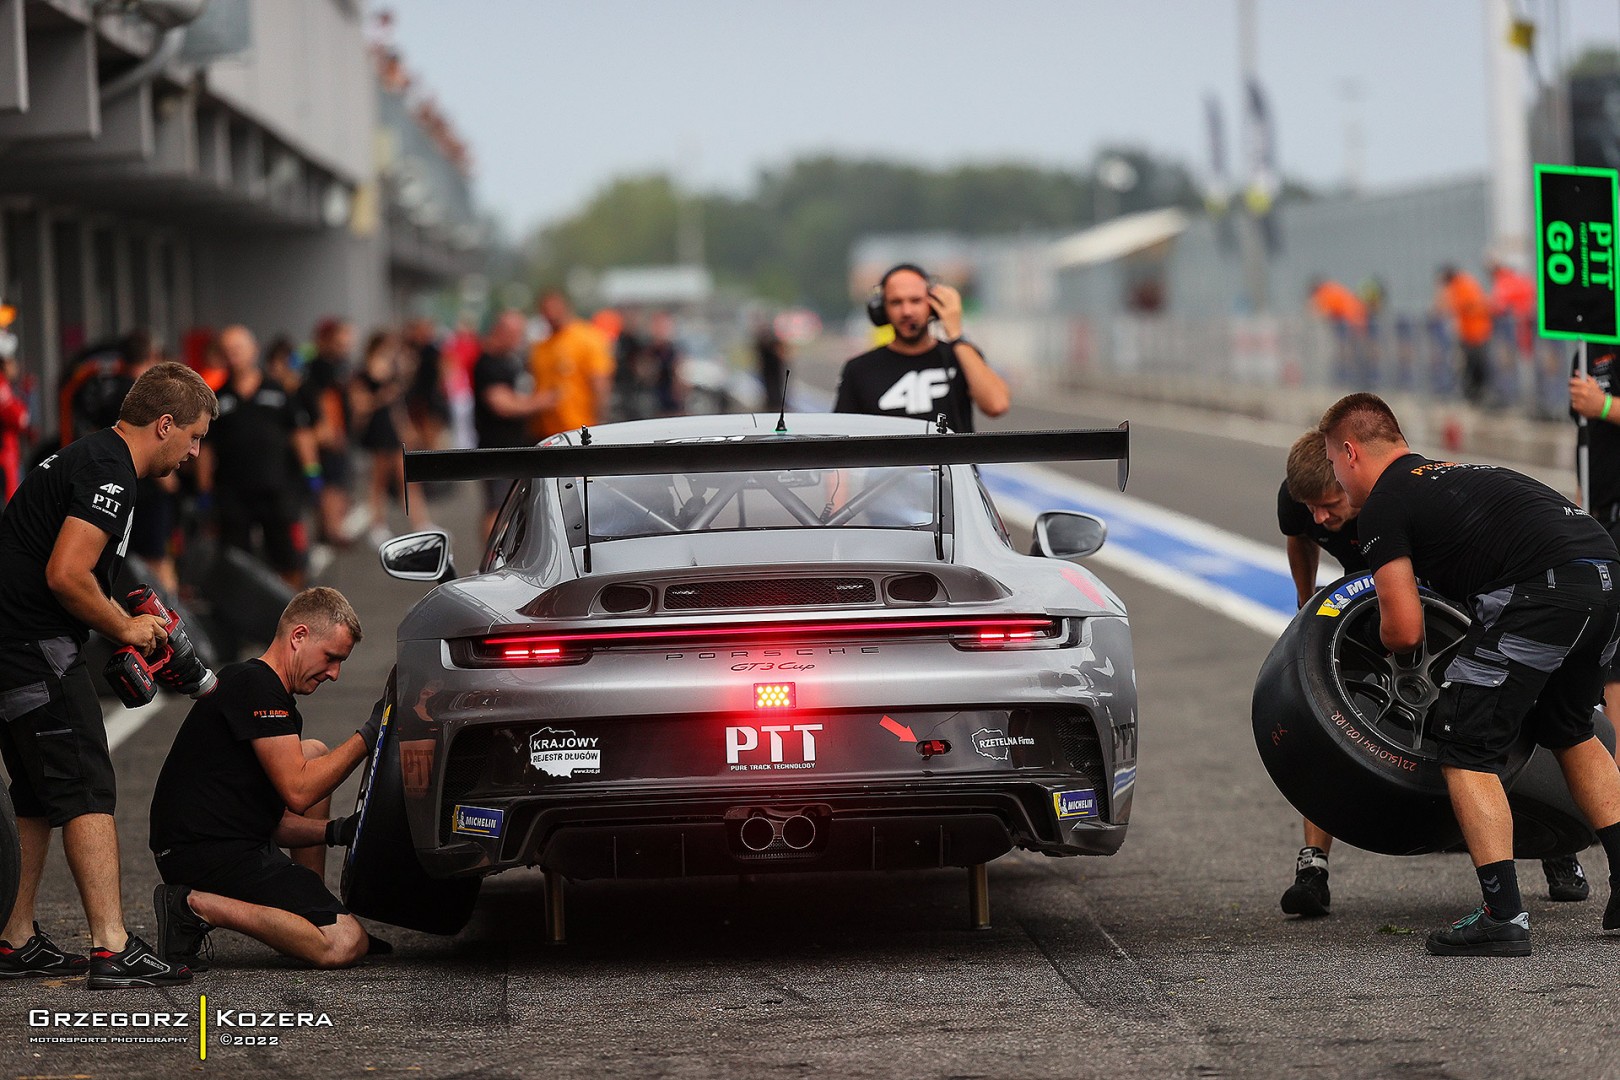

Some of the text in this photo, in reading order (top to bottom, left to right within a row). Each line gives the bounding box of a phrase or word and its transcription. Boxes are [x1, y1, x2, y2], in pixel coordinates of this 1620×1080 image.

[1546, 220, 1575, 285] GO
[1589, 221, 1613, 291] PTT
[878, 366, 957, 415] 4F
[100, 482, 124, 495] 4F
[92, 493, 122, 513] PTT
[666, 646, 880, 660] PORSCHE
[778, 661, 816, 672] Cup
[533, 737, 599, 750] KRAJOWY
[725, 723, 823, 764] PTT
[979, 736, 1018, 748] RZETELNA
[533, 751, 599, 763] REJESTR DŁUGÓW
[773, 762, 816, 770] TECHNOLOGY
[1067, 798, 1093, 811] MICHELIN
[465, 815, 497, 829] MICHELIN
